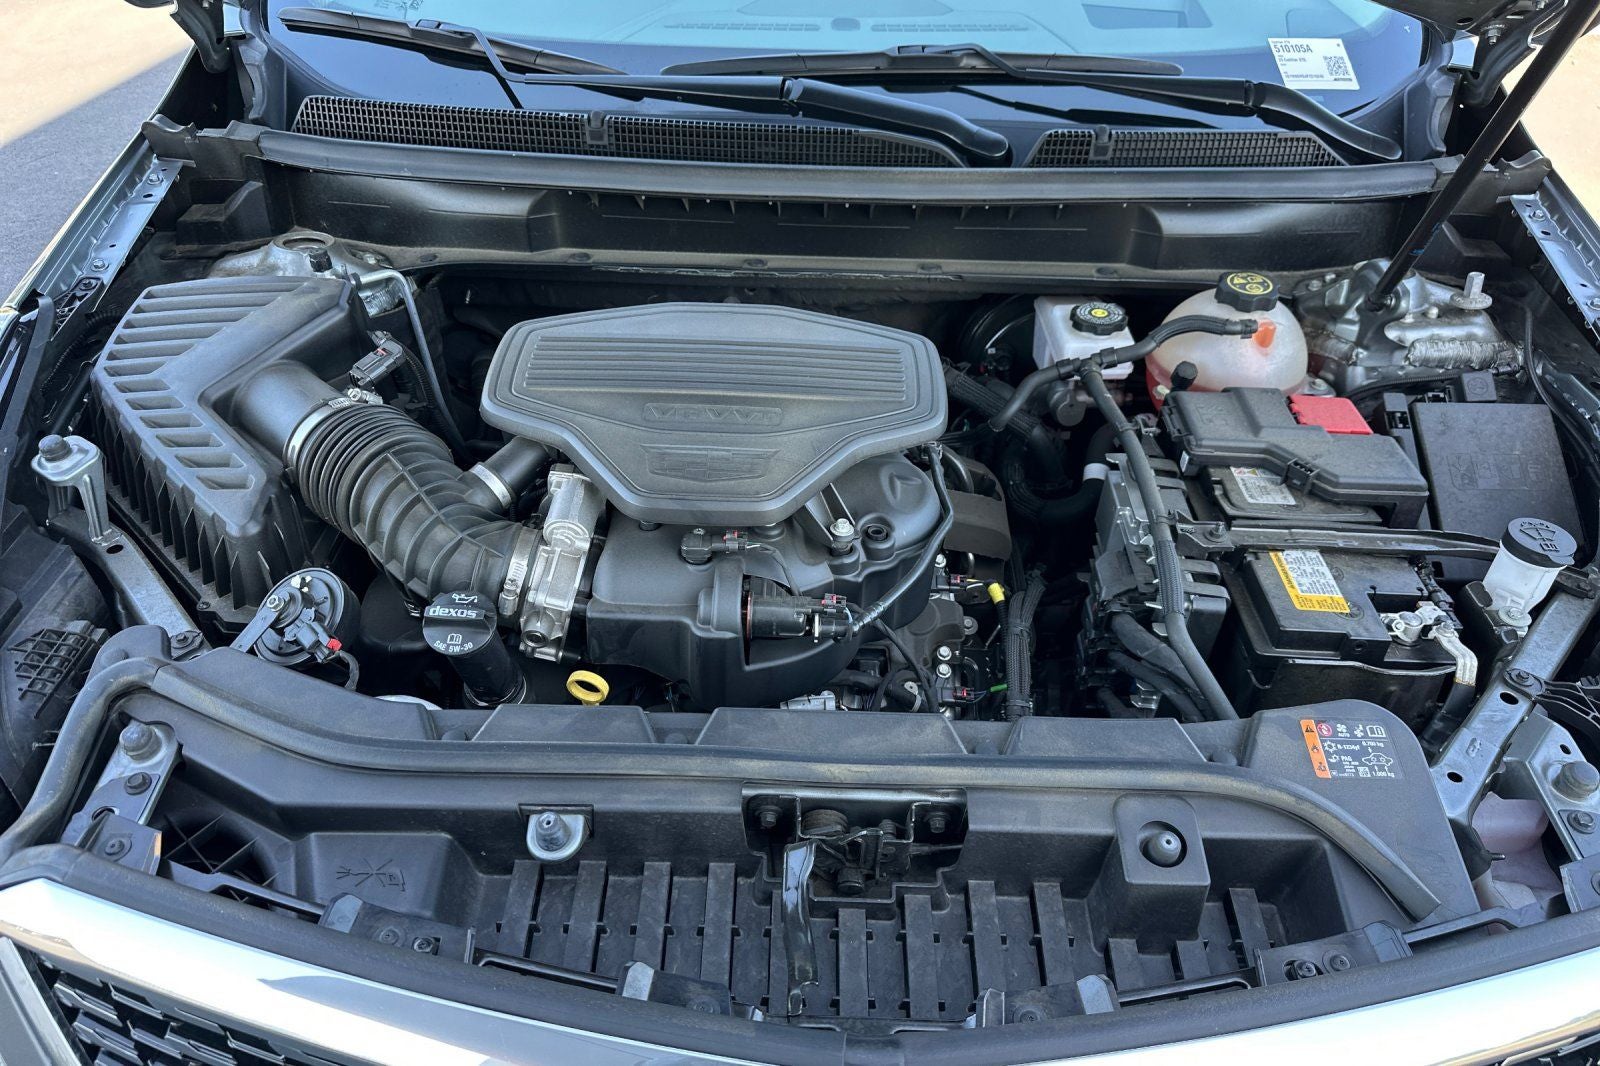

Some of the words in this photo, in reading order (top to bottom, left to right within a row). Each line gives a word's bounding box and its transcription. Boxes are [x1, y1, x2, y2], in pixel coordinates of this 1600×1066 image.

[1274, 44, 1312, 53] 510105A
[429, 606, 477, 618] dexos
[433, 640, 447, 651] SAE
[448, 642, 474, 653] 5W-30
